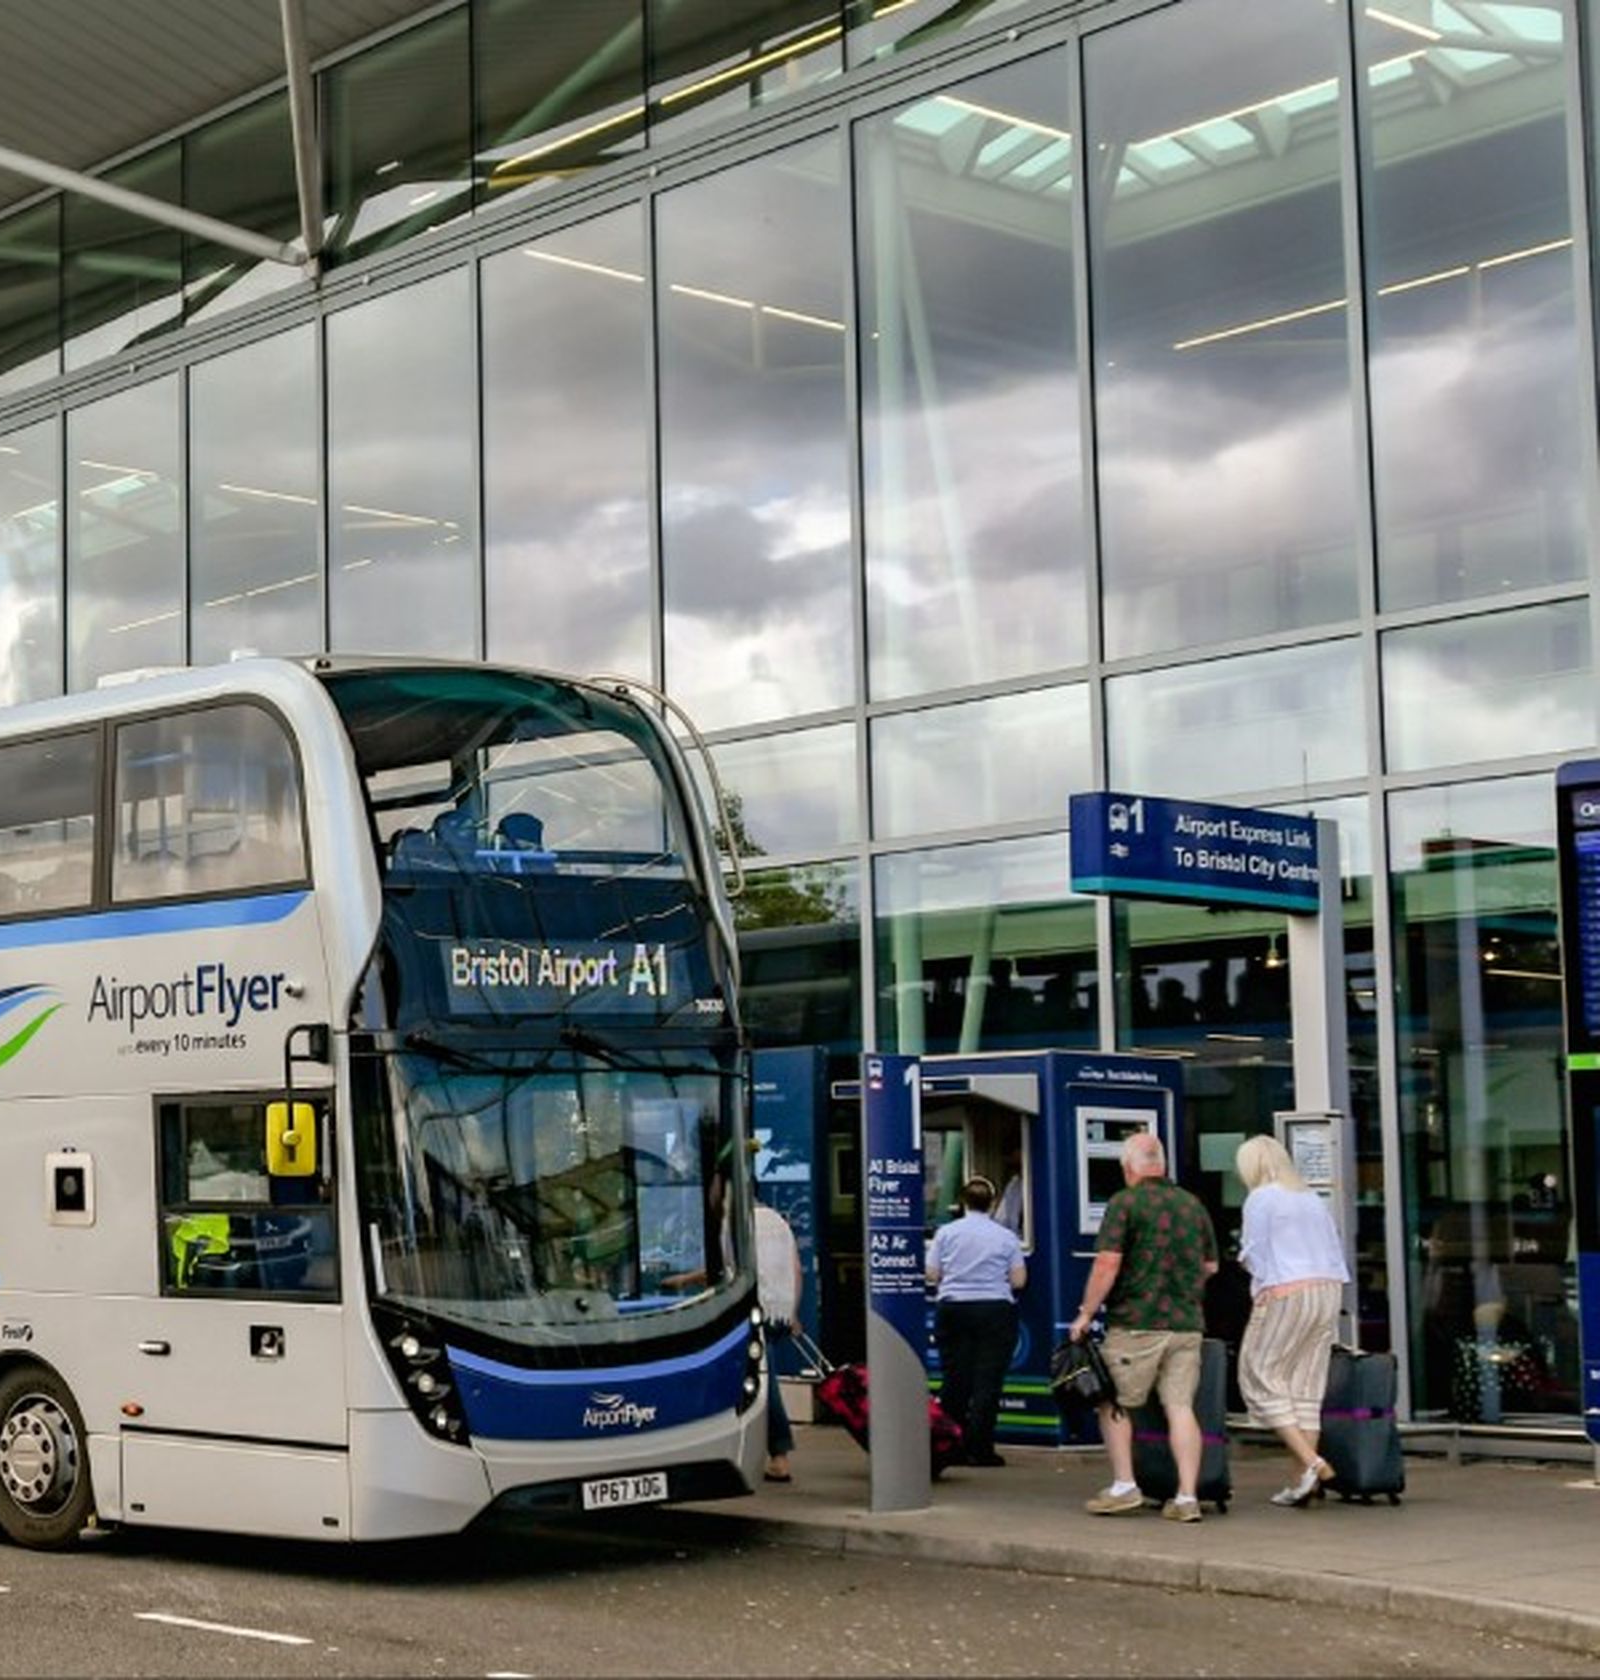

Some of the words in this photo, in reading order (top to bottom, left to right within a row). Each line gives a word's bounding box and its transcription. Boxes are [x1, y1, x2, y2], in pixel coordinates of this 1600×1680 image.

[1129, 799, 1145, 834] 1
[1174, 815, 1227, 841] Airport
[1230, 820, 1283, 845] Express
[1285, 828, 1312, 849] Link
[1173, 846, 1195, 868] To
[1197, 849, 1246, 873] Bristol
[1249, 855, 1276, 881] City
[451, 947, 529, 986] Bristol
[537, 947, 619, 996] Airport
[628, 943, 669, 996] A1
[88, 963, 284, 1034] AirportFlyer
[135, 1038, 171, 1057] every
[174, 1034, 190, 1051] 10
[192, 1032, 247, 1050] minutes
[904, 1063, 921, 1150] 1
[868, 1160, 883, 1174] A1
[886, 1159, 920, 1174] Bristol
[868, 1176, 900, 1195] Flyer
[872, 1234, 889, 1250] A2
[872, 1252, 917, 1268] Connect
[583, 1402, 658, 1430] AirportFlyer
[588, 1479, 630, 1504] YP67
